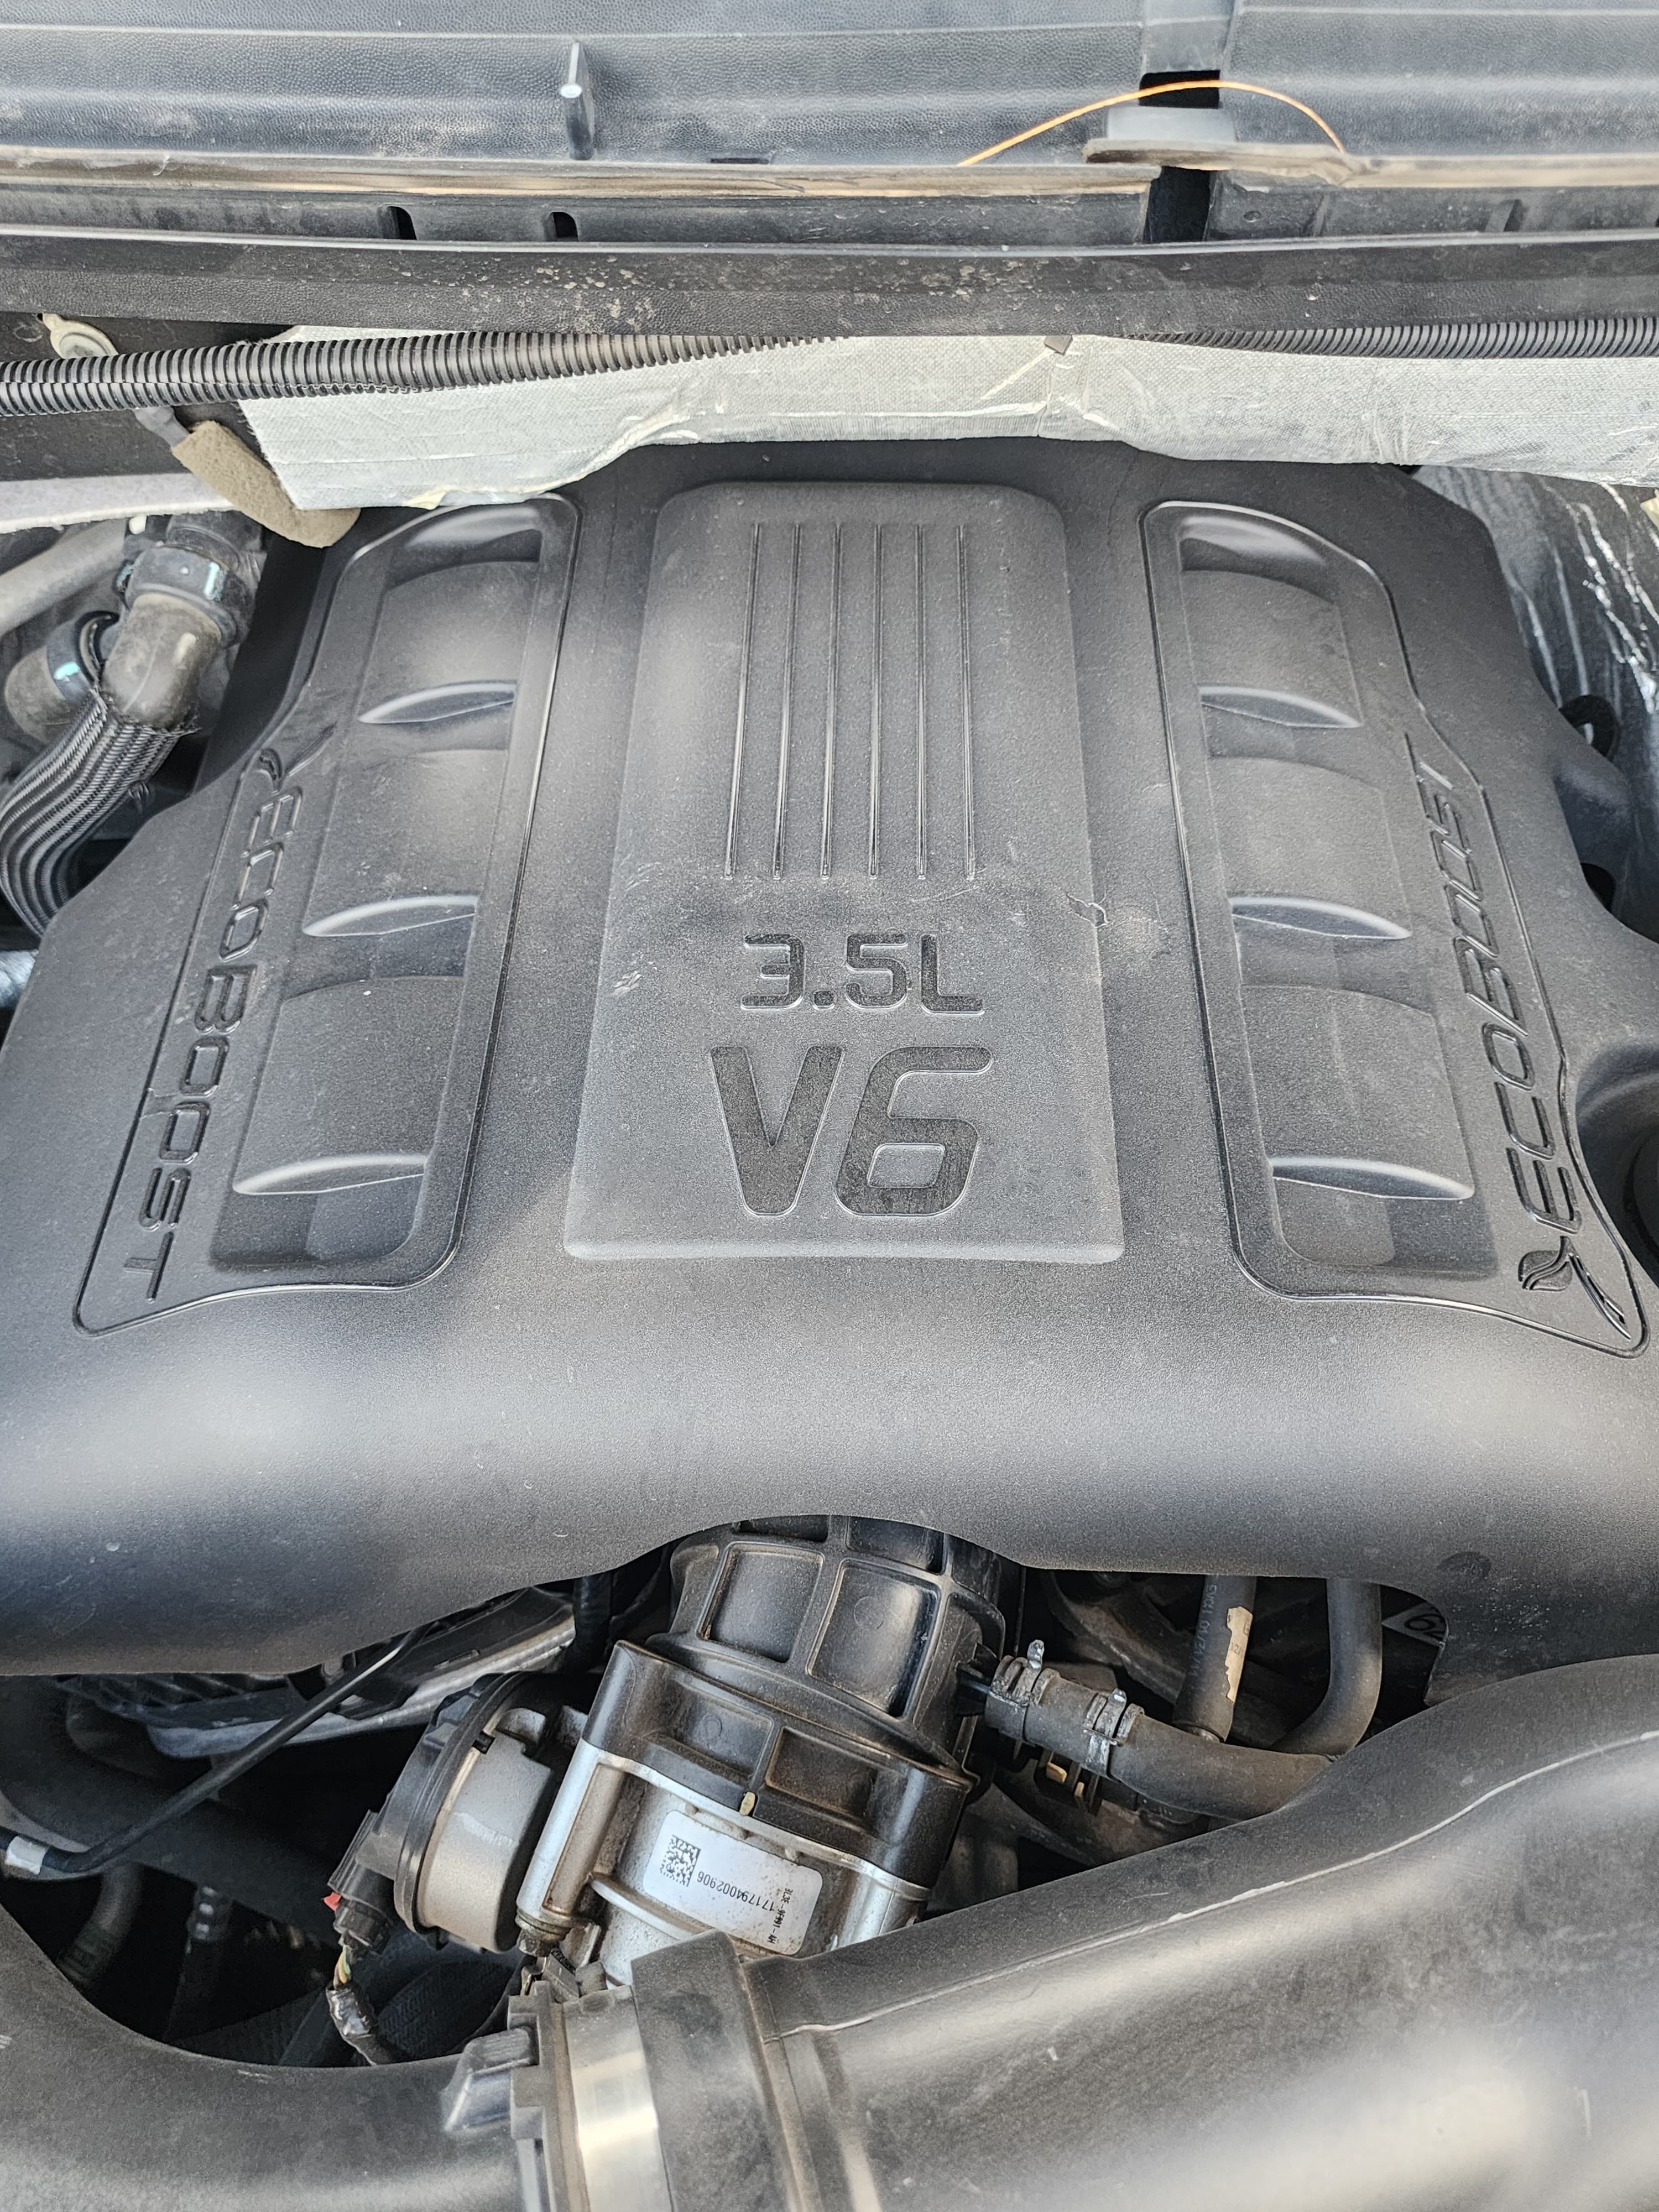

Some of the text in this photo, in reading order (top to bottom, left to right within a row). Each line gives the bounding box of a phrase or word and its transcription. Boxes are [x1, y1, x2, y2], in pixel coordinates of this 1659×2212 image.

[123, 785, 304, 1303] ECOBOOST
[740, 933, 985, 1015] 3.5L
[1405, 732, 1582, 1236] ECOBOOST
[711, 1046, 993, 1217] V6
[696, 1871, 775, 1912] 171794002906
